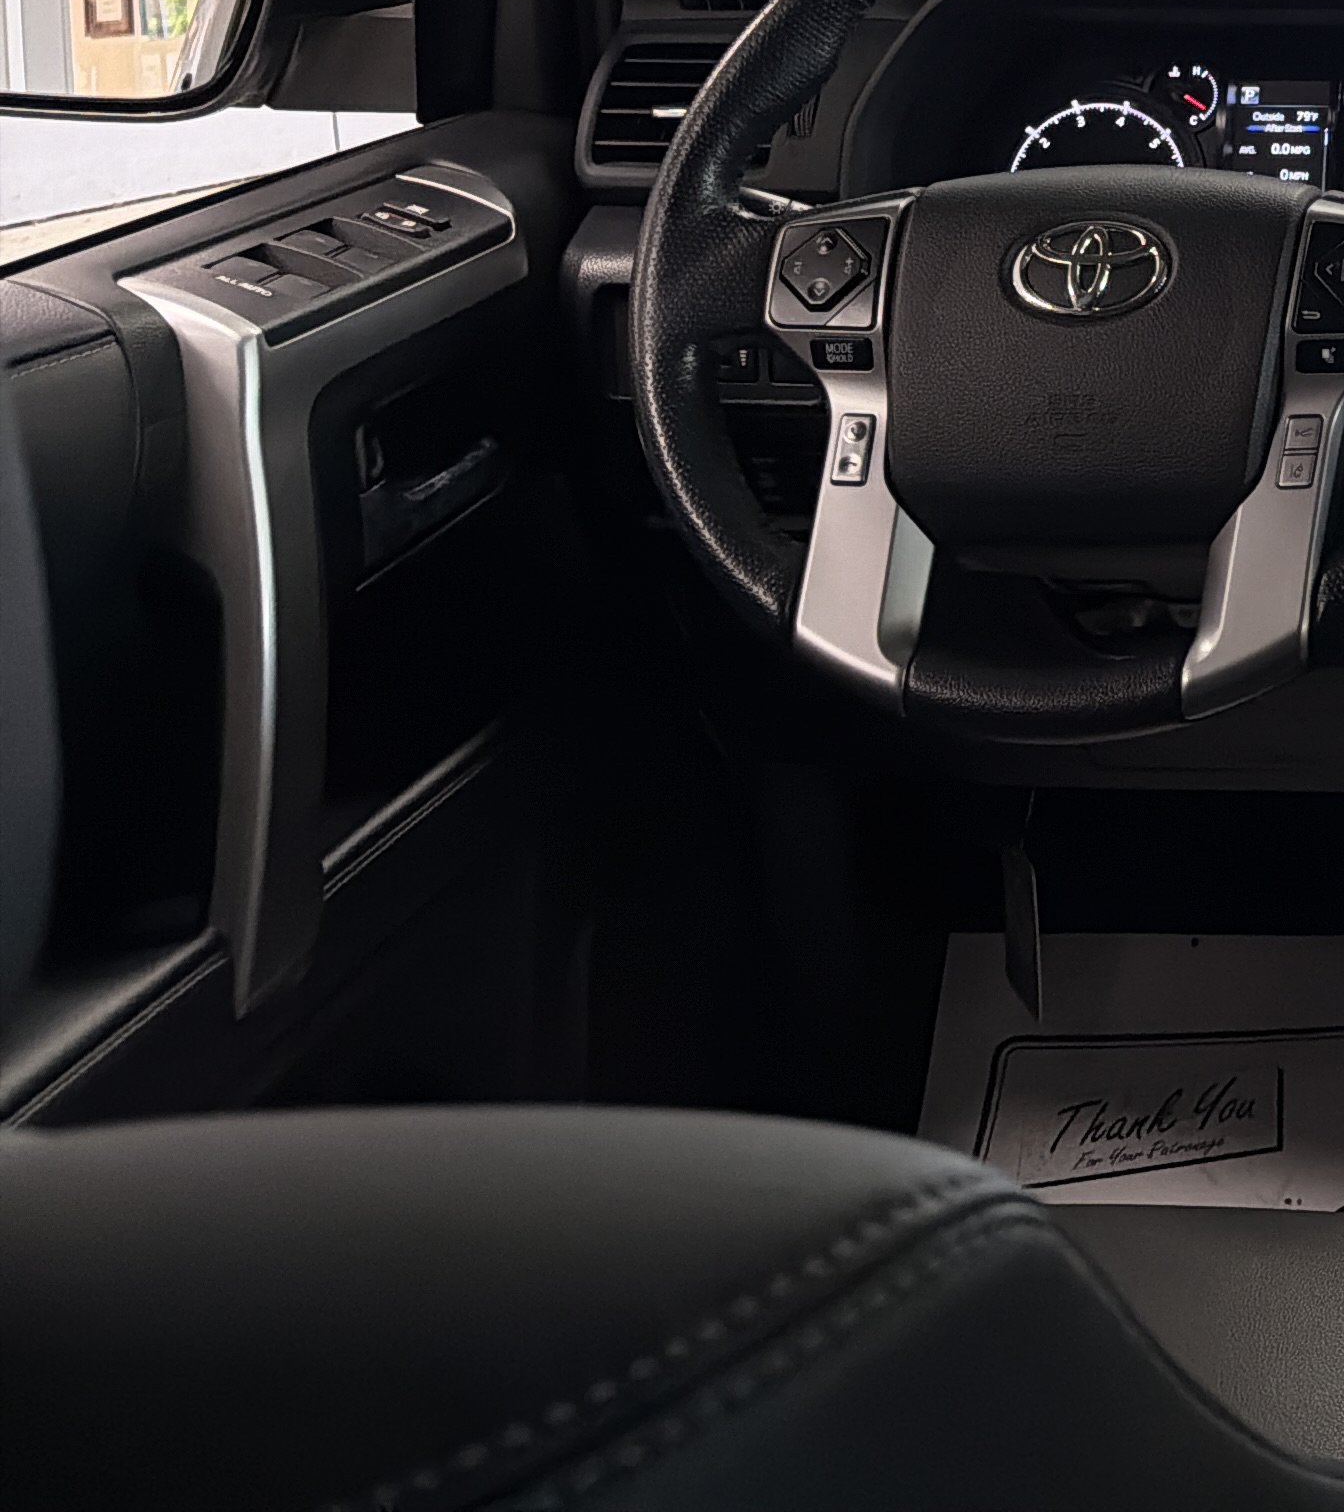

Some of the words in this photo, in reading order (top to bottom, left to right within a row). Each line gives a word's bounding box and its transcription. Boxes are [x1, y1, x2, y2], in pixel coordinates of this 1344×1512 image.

[1076, 115, 1086, 128] 3
[1115, 116, 1126, 128] 4
[1189, 115, 1199, 126] C
[1252, 111, 1285, 122] Outside
[1039, 137, 1051, 149] 2
[1149, 137, 1161, 149] 5
[825, 342, 854, 353] MODE
[1050, 1088, 1183, 1154] Thank
[1194, 1076, 1255, 1130] You
[1072, 1151, 1102, 1170] For
[1109, 1145, 1144, 1168] Your
[1147, 1136, 1226, 1159] Patronage
